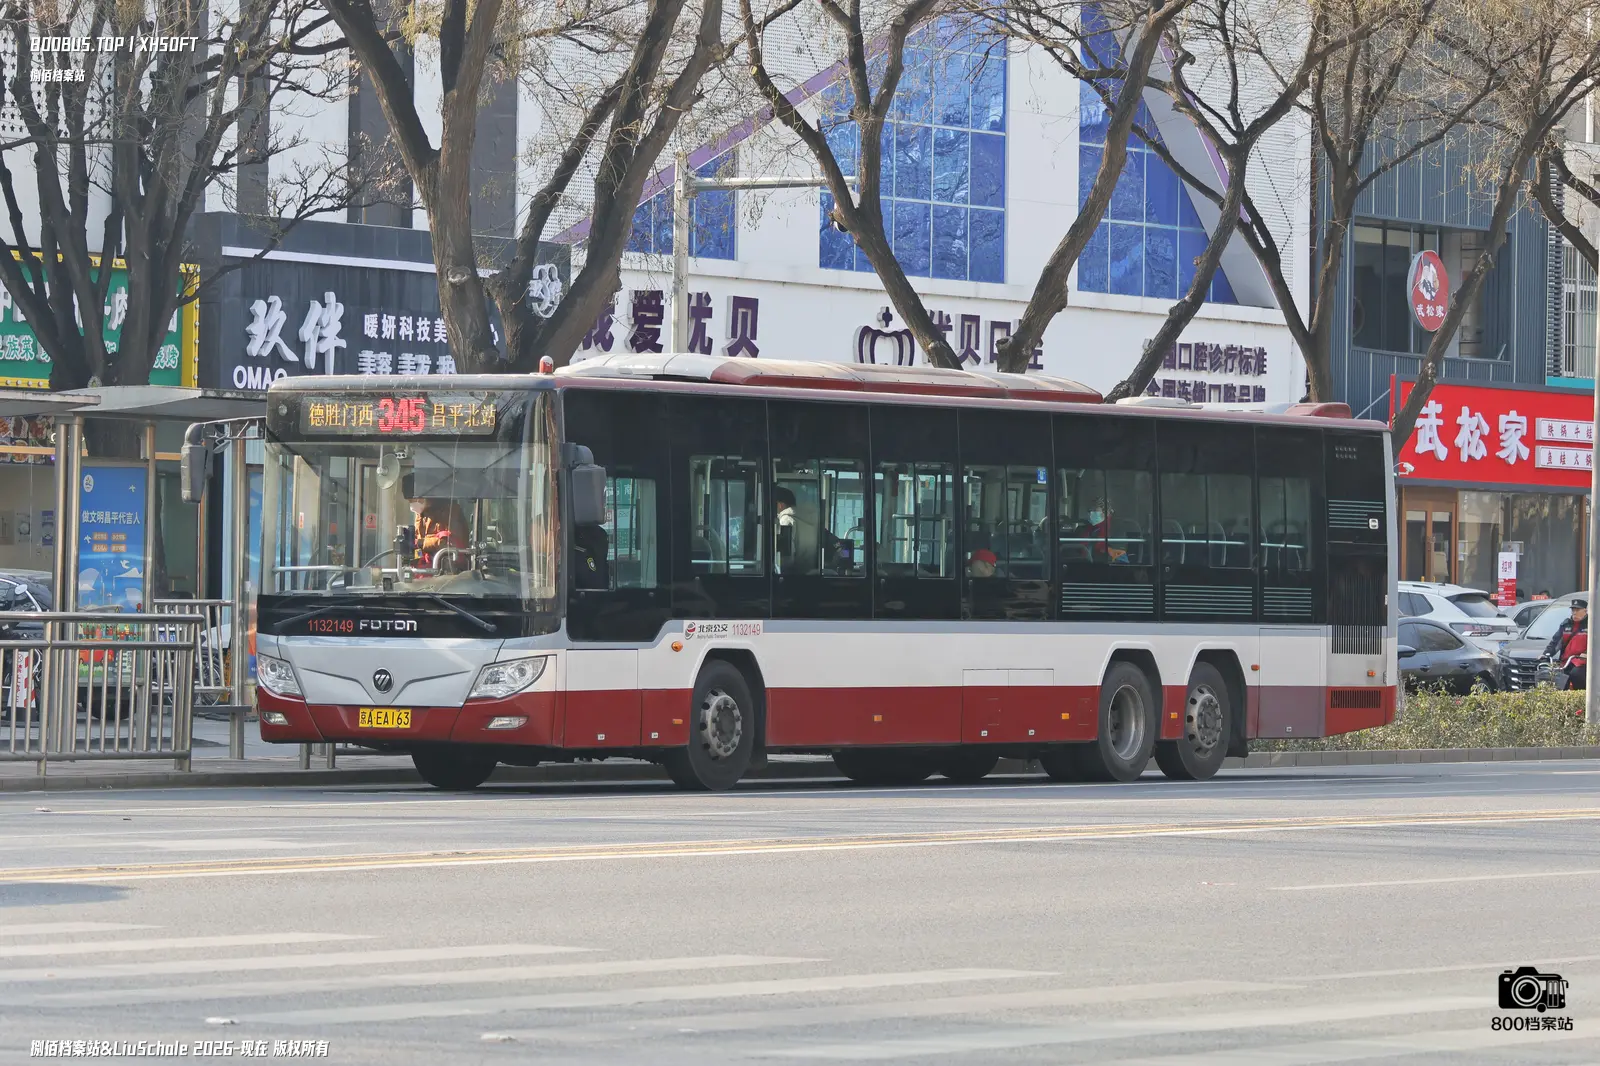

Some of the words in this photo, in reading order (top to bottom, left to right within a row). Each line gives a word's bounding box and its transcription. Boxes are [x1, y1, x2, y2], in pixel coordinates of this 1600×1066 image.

[1416, 303, 1444, 318] 武松家
[246, 291, 347, 376] 玖伴
[364, 313, 448, 344] 暖妍科技美
[0, 334, 35, 361] 族菜
[1143, 338, 1267, 376] 国口腔诊疗标准
[309, 403, 373, 427] 德胜门西
[377, 398, 426, 432] 345
[432, 403, 497, 428] 昌平北站
[1414, 400, 1530, 465] 武松家
[82, 510, 140, 524] 做文明昌平代言人
[308, 620, 354, 632] 1132149
[698, 624, 728, 632] 北京公交
[732, 624, 761, 635] 1132149
